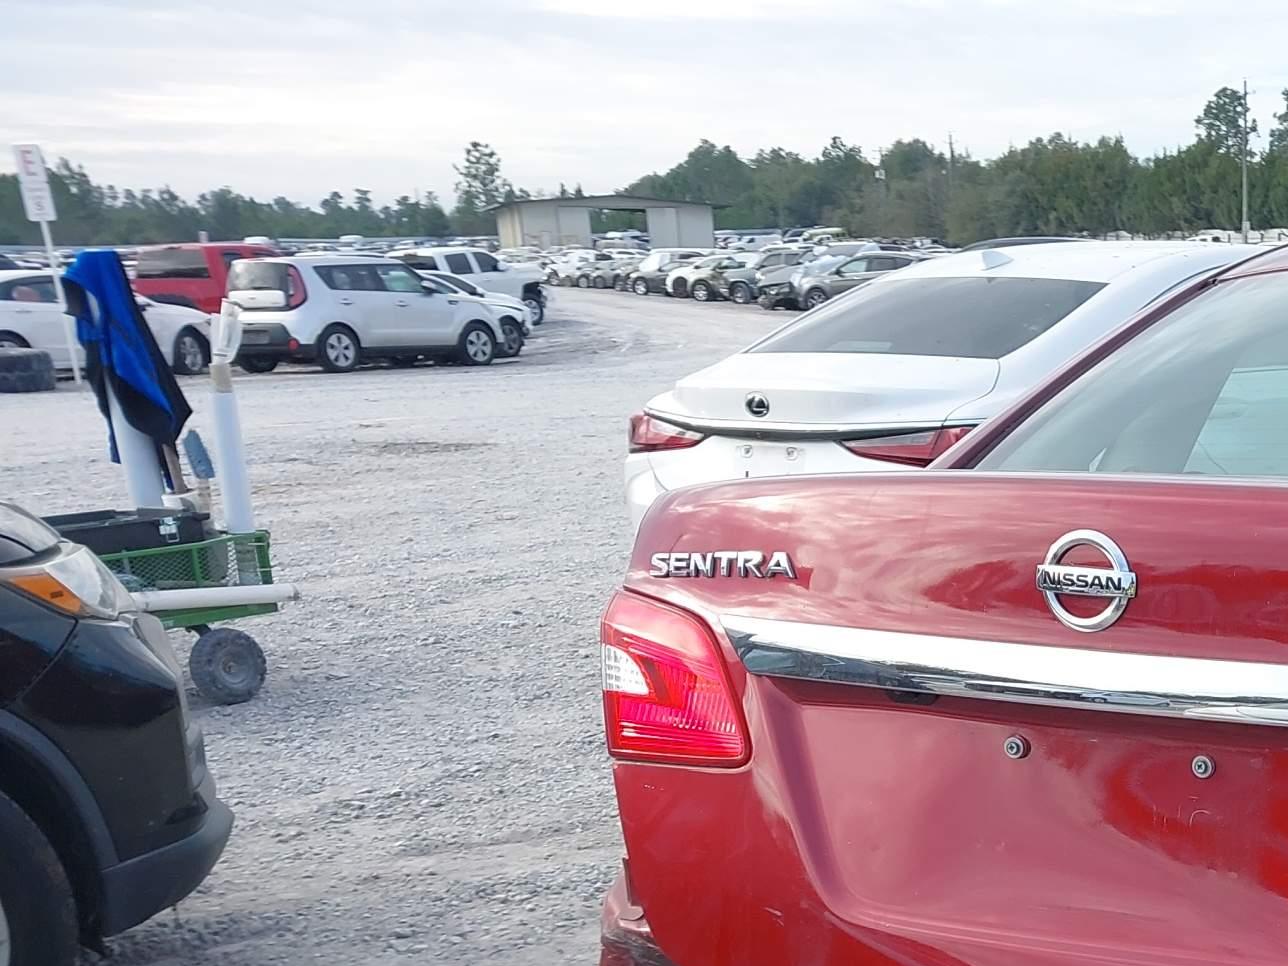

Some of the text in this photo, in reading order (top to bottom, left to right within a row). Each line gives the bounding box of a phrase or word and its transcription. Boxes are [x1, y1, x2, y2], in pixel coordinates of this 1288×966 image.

[20, 149, 36, 177] E
[649, 550, 796, 579] SENTRA
[1041, 569, 1123, 592] NISSAN
